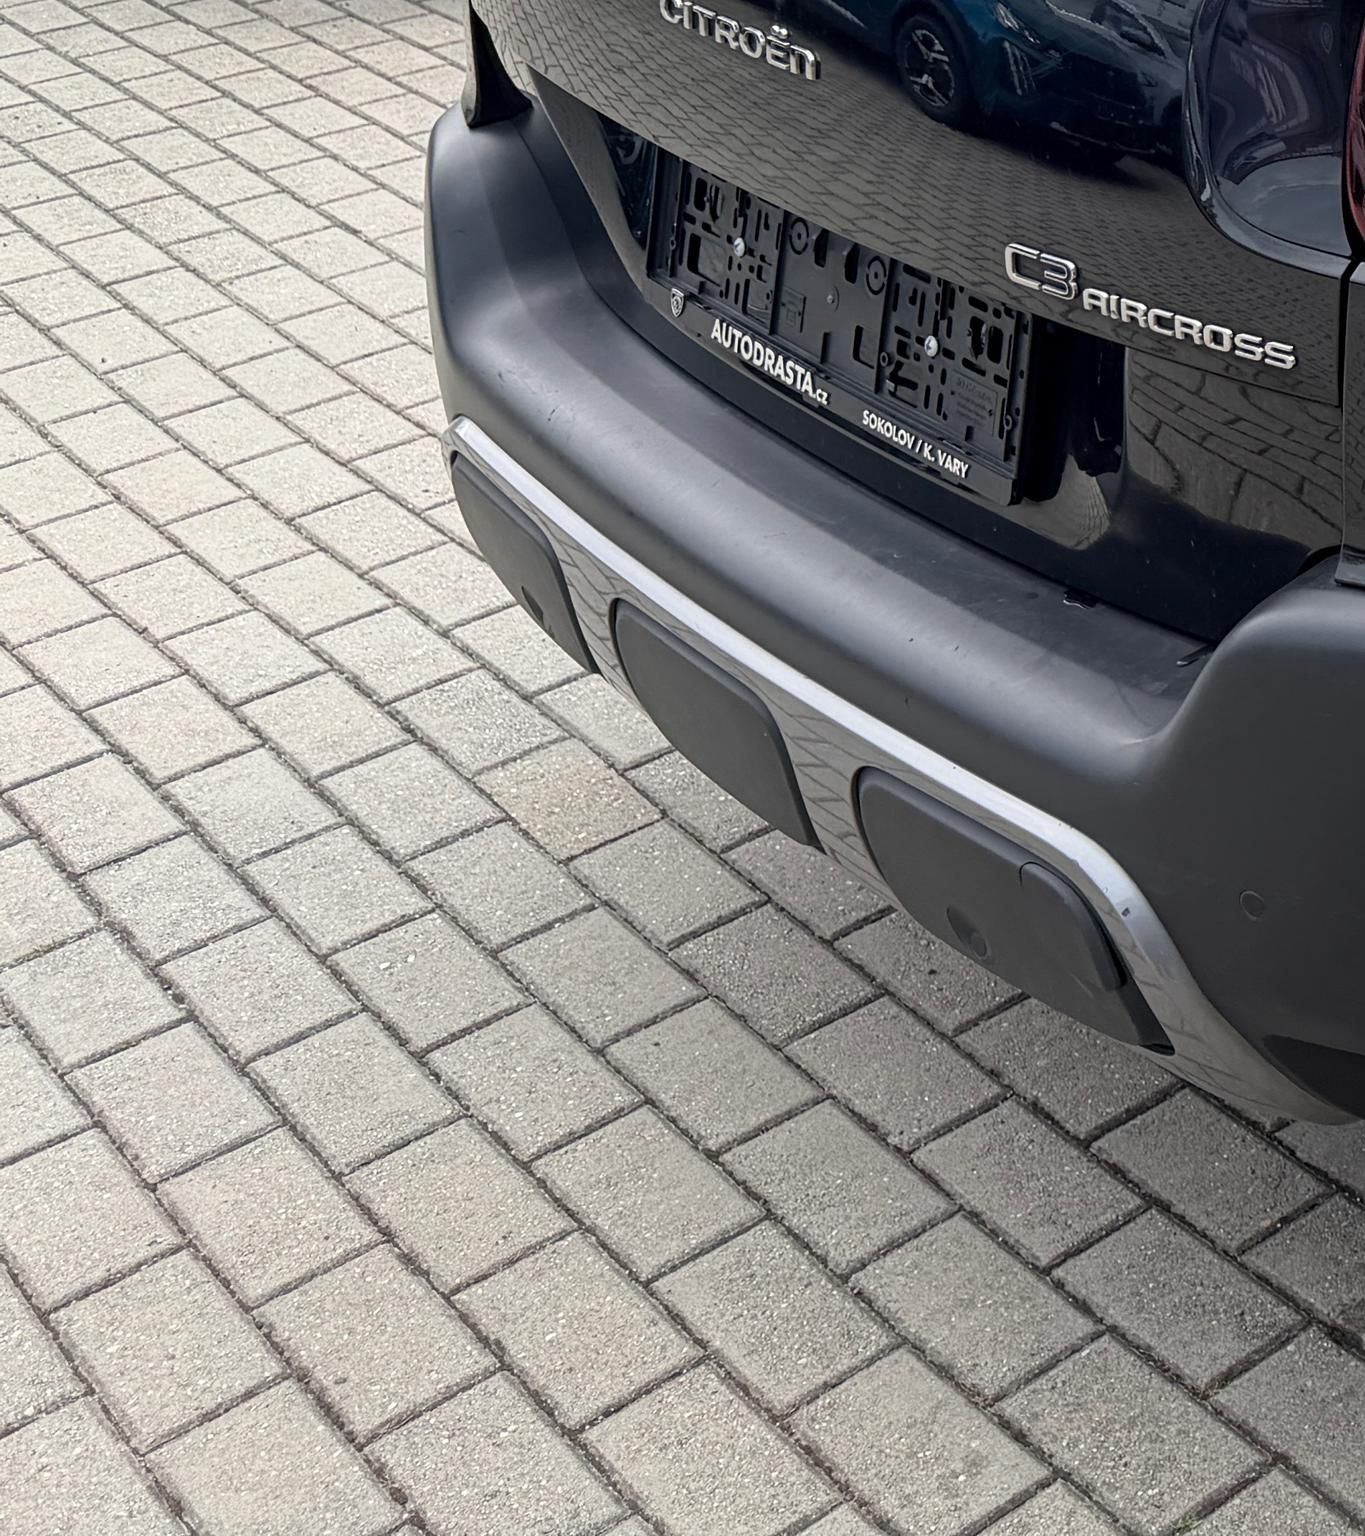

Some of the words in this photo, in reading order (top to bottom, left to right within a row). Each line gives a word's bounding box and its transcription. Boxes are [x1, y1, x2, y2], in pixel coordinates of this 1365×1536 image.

[1004, 242, 1079, 301] C3
[1081, 288, 1297, 370] AIRCROSS
[710, 317, 830, 406] AUTODRASTA.cz
[861, 409, 915, 454] SOKOLOV
[922, 440, 936, 464] K.
[937, 448, 970, 480] VARY
